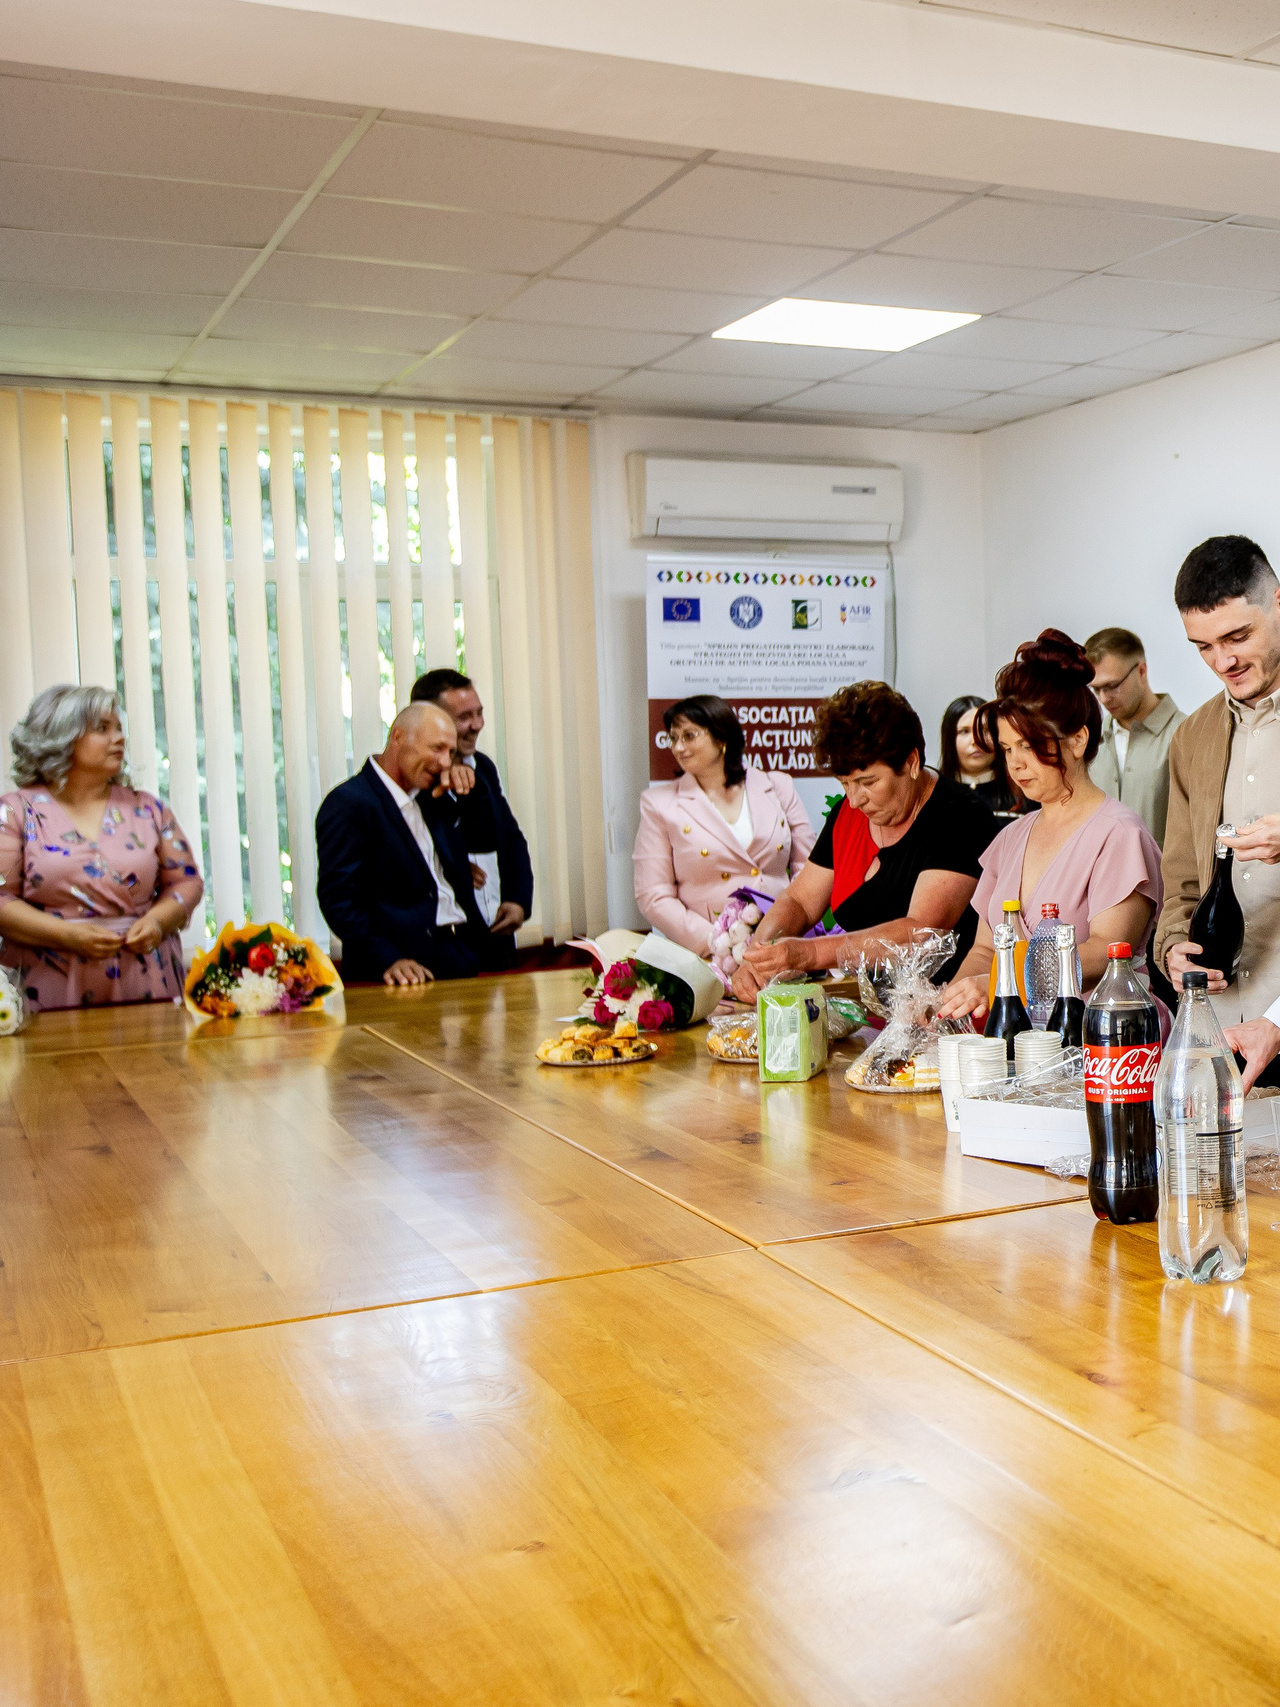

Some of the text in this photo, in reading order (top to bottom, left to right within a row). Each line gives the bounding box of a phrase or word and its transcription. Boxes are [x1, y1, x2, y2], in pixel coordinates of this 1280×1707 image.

[732, 706, 816, 728] SOCIAȚIA
[1083, 1045, 1160, 1085] Coca-Cola
[1088, 1087, 1148, 1096] GUST ORIGINAL
